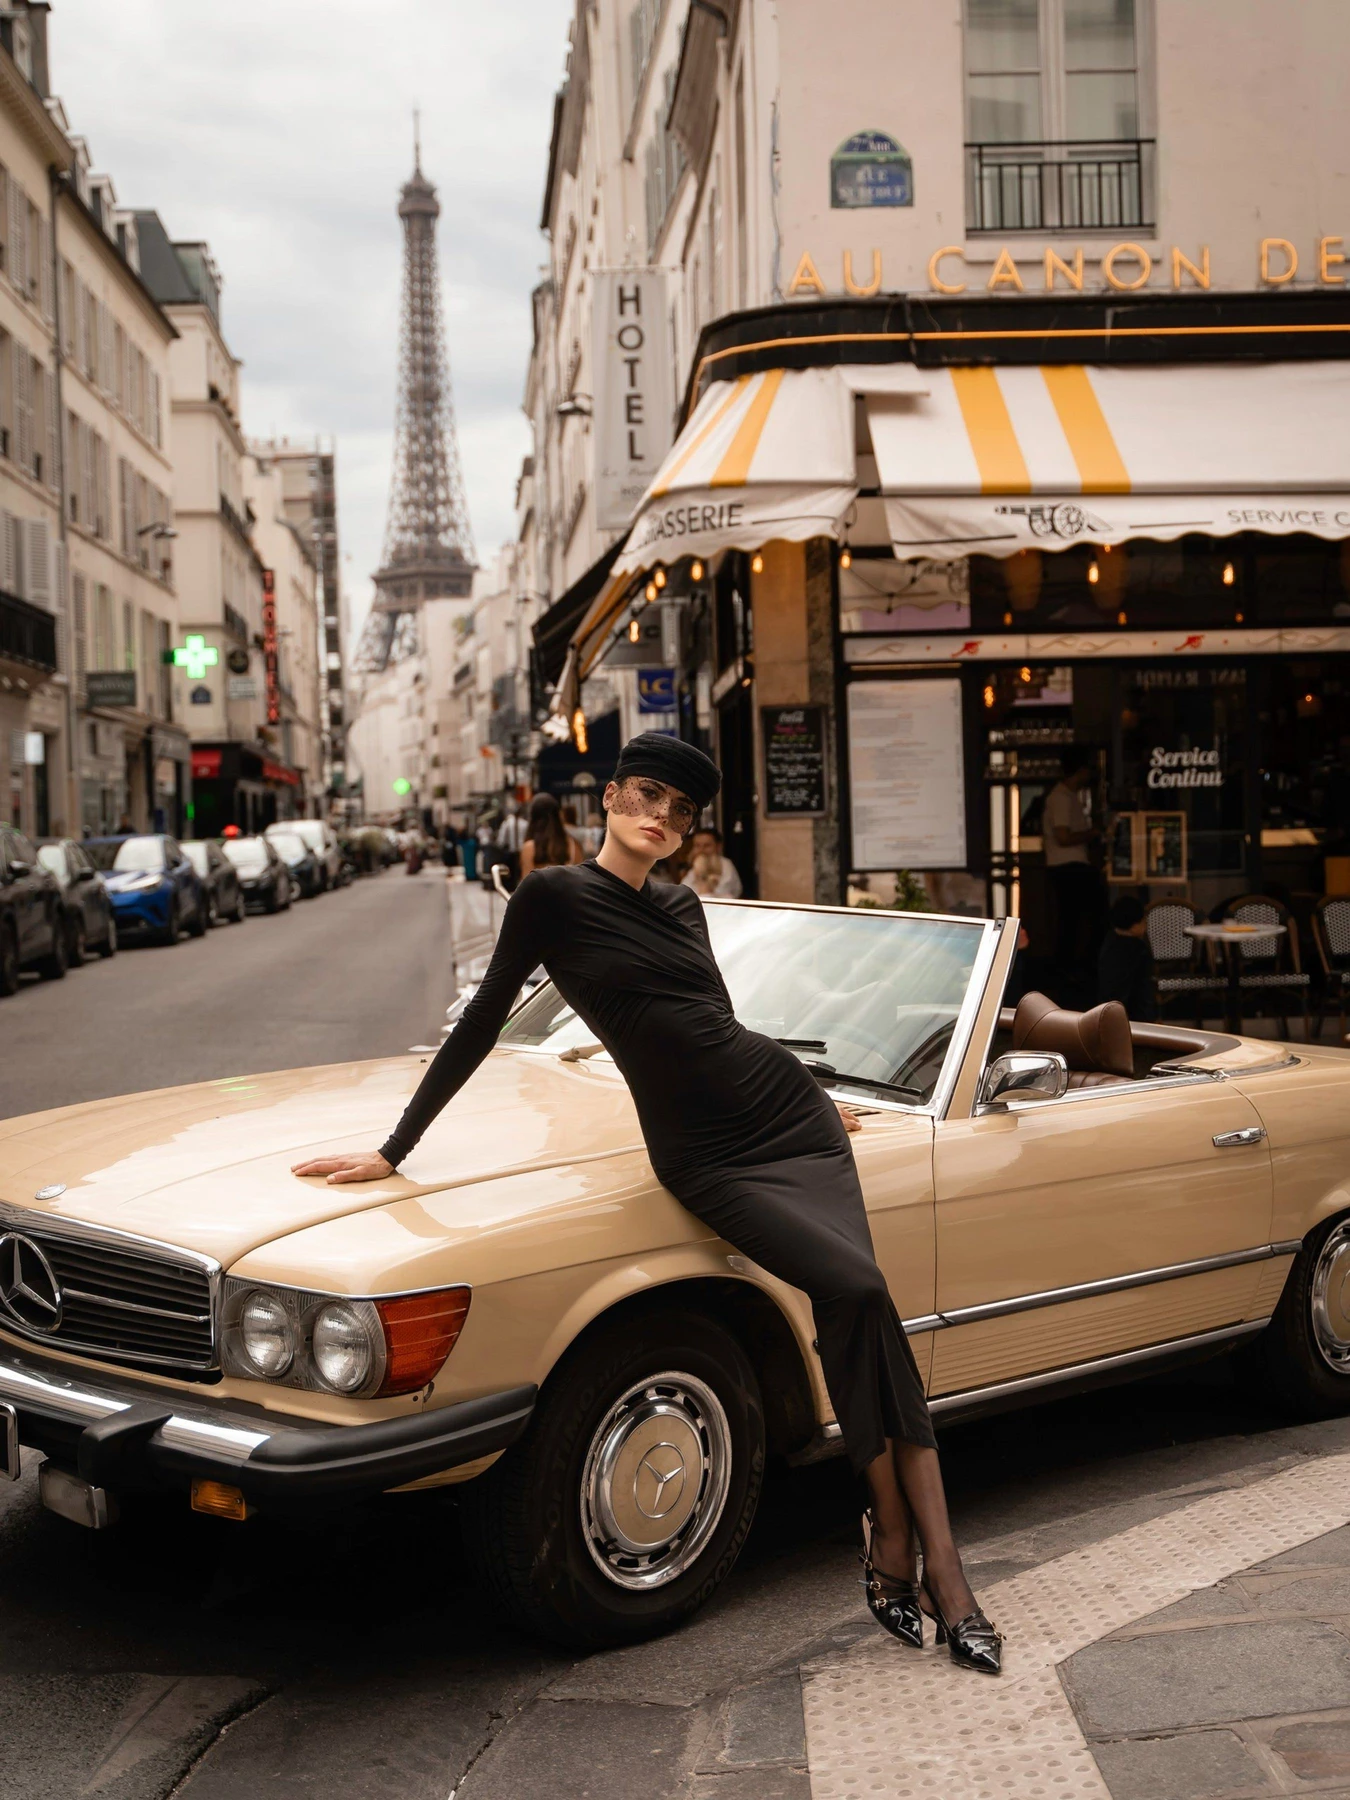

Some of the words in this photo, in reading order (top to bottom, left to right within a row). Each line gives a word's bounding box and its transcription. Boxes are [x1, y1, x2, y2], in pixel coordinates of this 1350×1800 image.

[788, 249, 882, 297] AU
[928, 242, 1211, 295] CANON
[1260, 236, 1346, 285] DE
[616, 283, 645, 461] HOTEL
[648, 503, 745, 543] ASSERIE
[1227, 509, 1329, 527] SERVICE
[1149, 747, 1219, 767] Service
[1147, 767, 1225, 789] Continu
